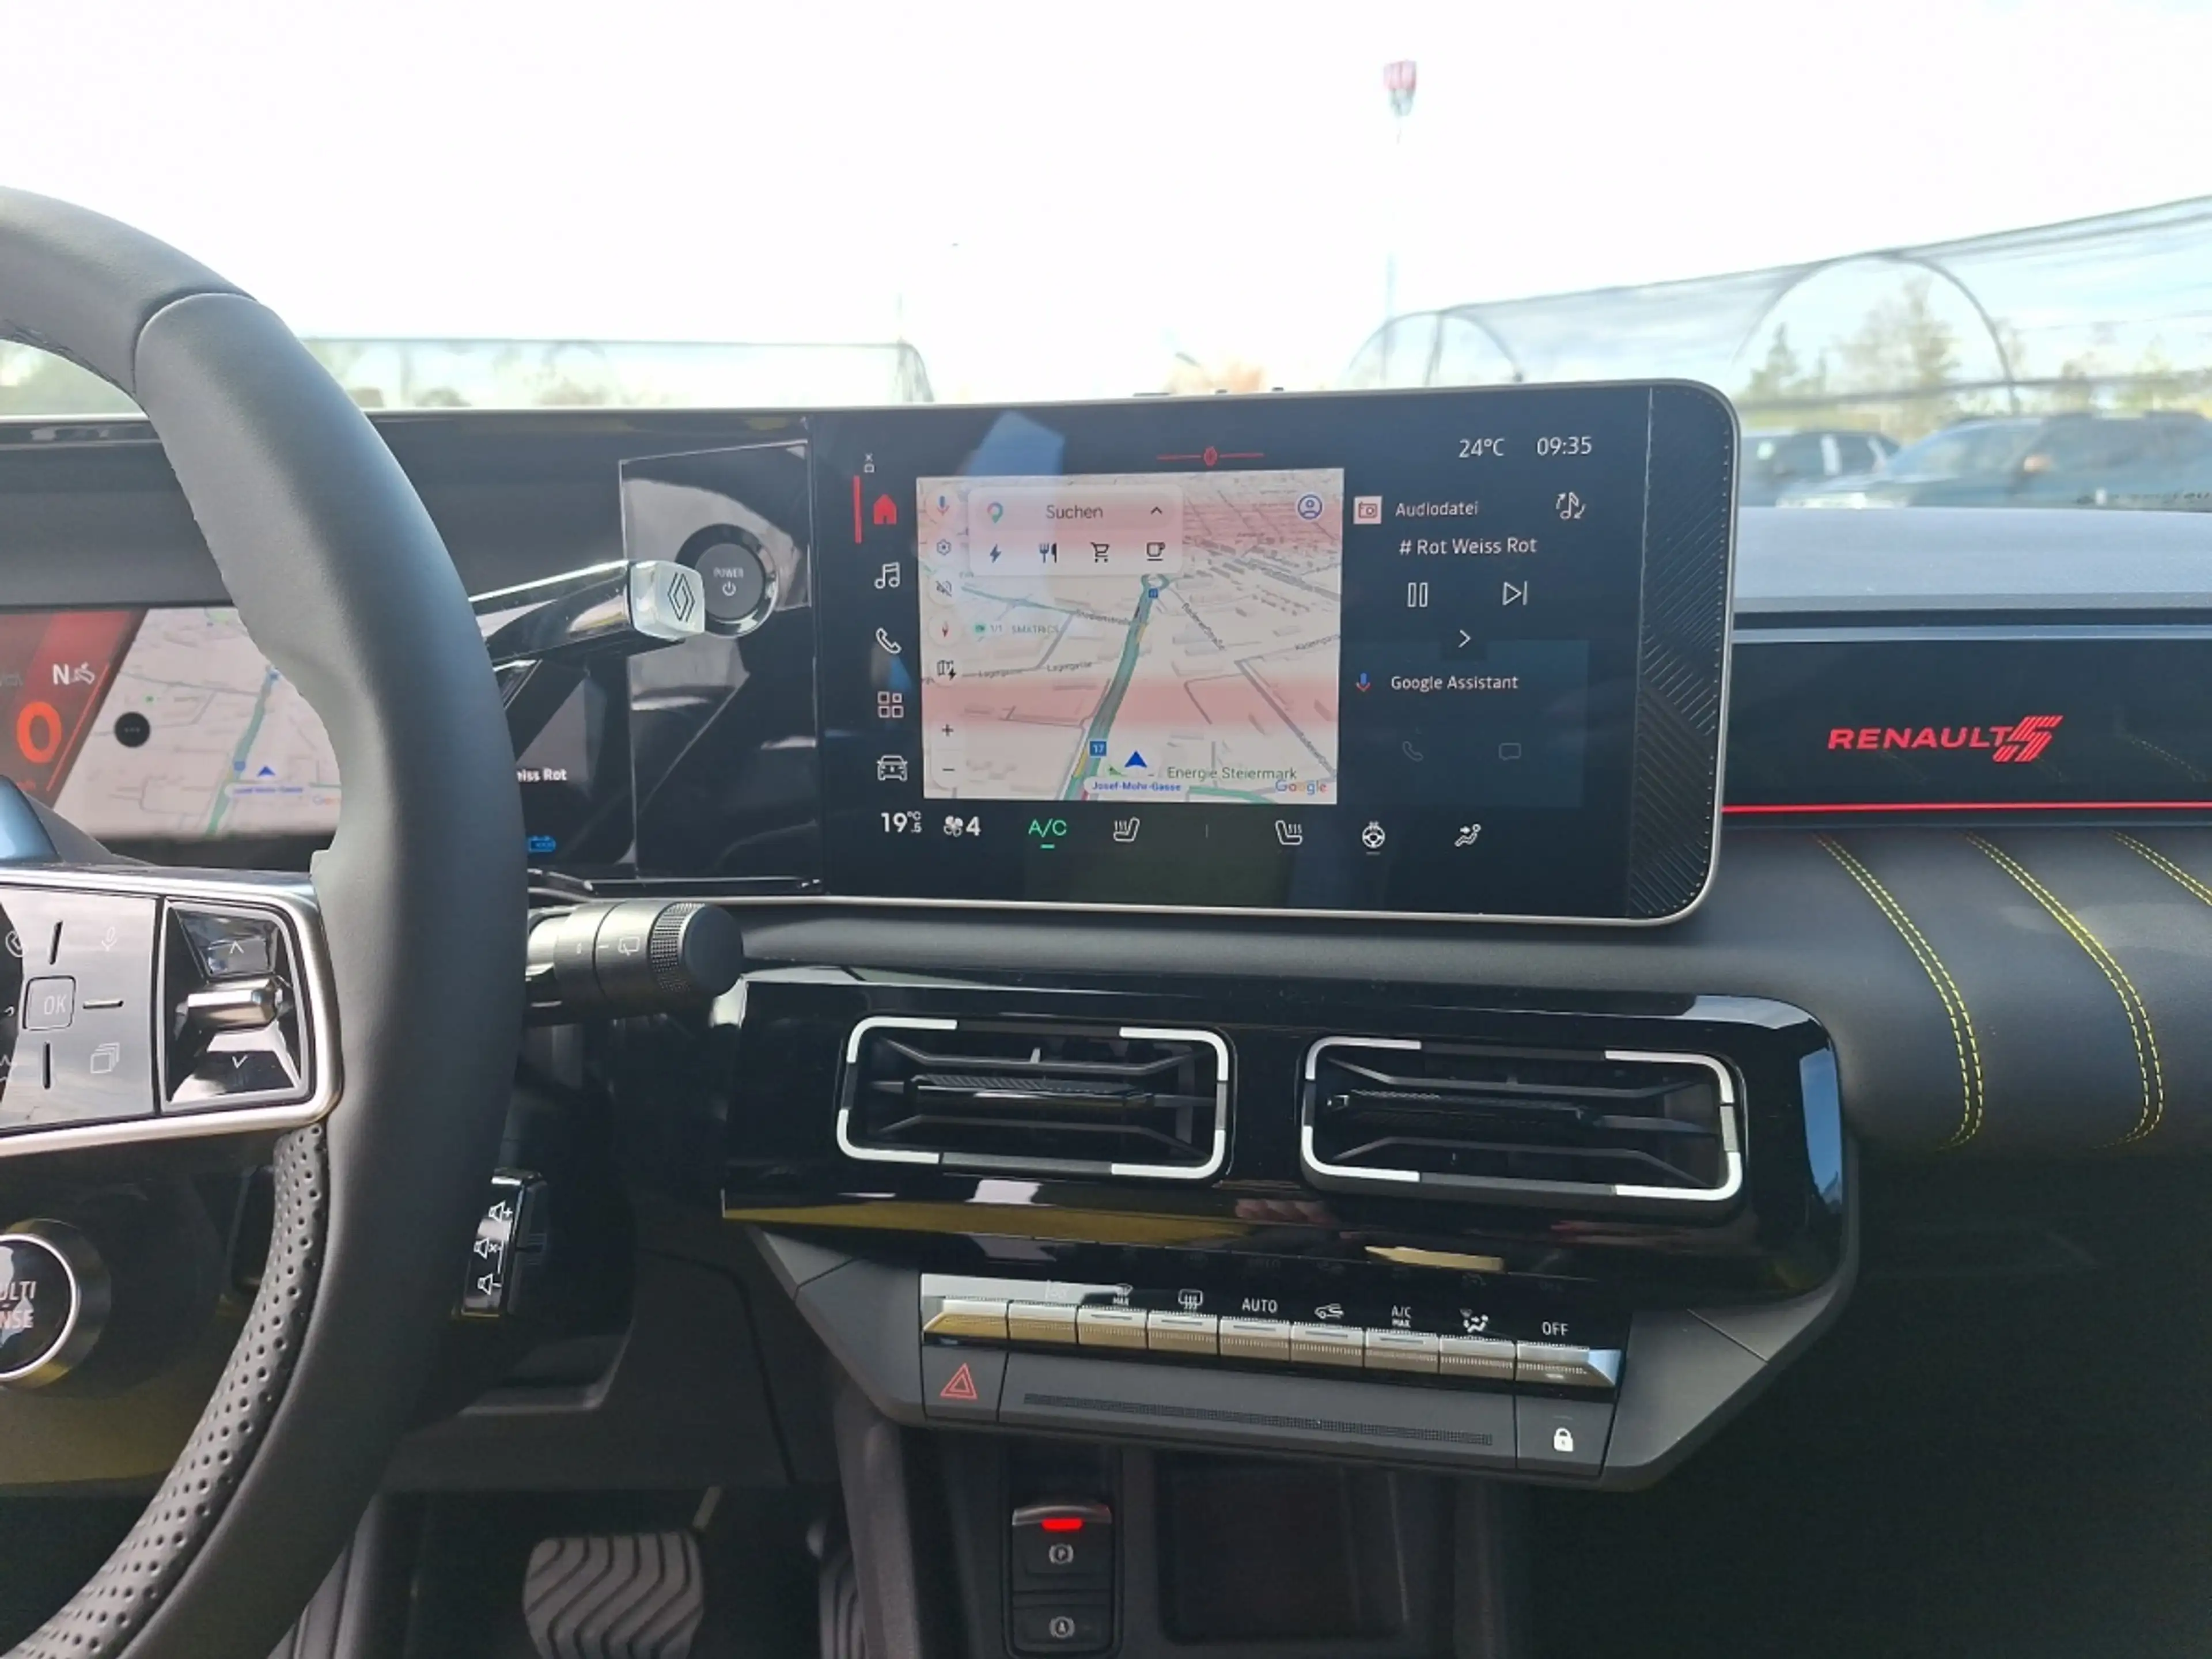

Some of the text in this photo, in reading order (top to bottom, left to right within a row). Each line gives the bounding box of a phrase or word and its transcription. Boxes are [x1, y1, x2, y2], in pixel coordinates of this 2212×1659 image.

[1458, 438, 1505, 458] 24°C
[1537, 436, 1593, 456] 09:35
[1046, 505, 1103, 520] Suchen
[1395, 501, 1479, 517] Audiodatei
[1416, 539, 1448, 555] Rot
[1452, 537, 1502, 555] Weiss
[1507, 536, 1537, 553] Rot
[713, 567, 744, 579] POWER
[52, 663, 69, 685] N
[1391, 675, 1519, 692] Google Assistant
[16, 700, 62, 764] 0
[1827, 726, 2014, 750] RENAULT
[543, 767, 567, 782] Rot
[1167, 767, 1297, 782] Energie Steiermark
[1275, 779, 1328, 795] Google
[965, 816, 982, 836] 4
[1028, 818, 1067, 838] A/C
[44, 994, 67, 1015] OK
[1242, 1297, 1279, 1314] AUTO
[1391, 1305, 1411, 1319] A/C
[1541, 1321, 1569, 1336] OFF
